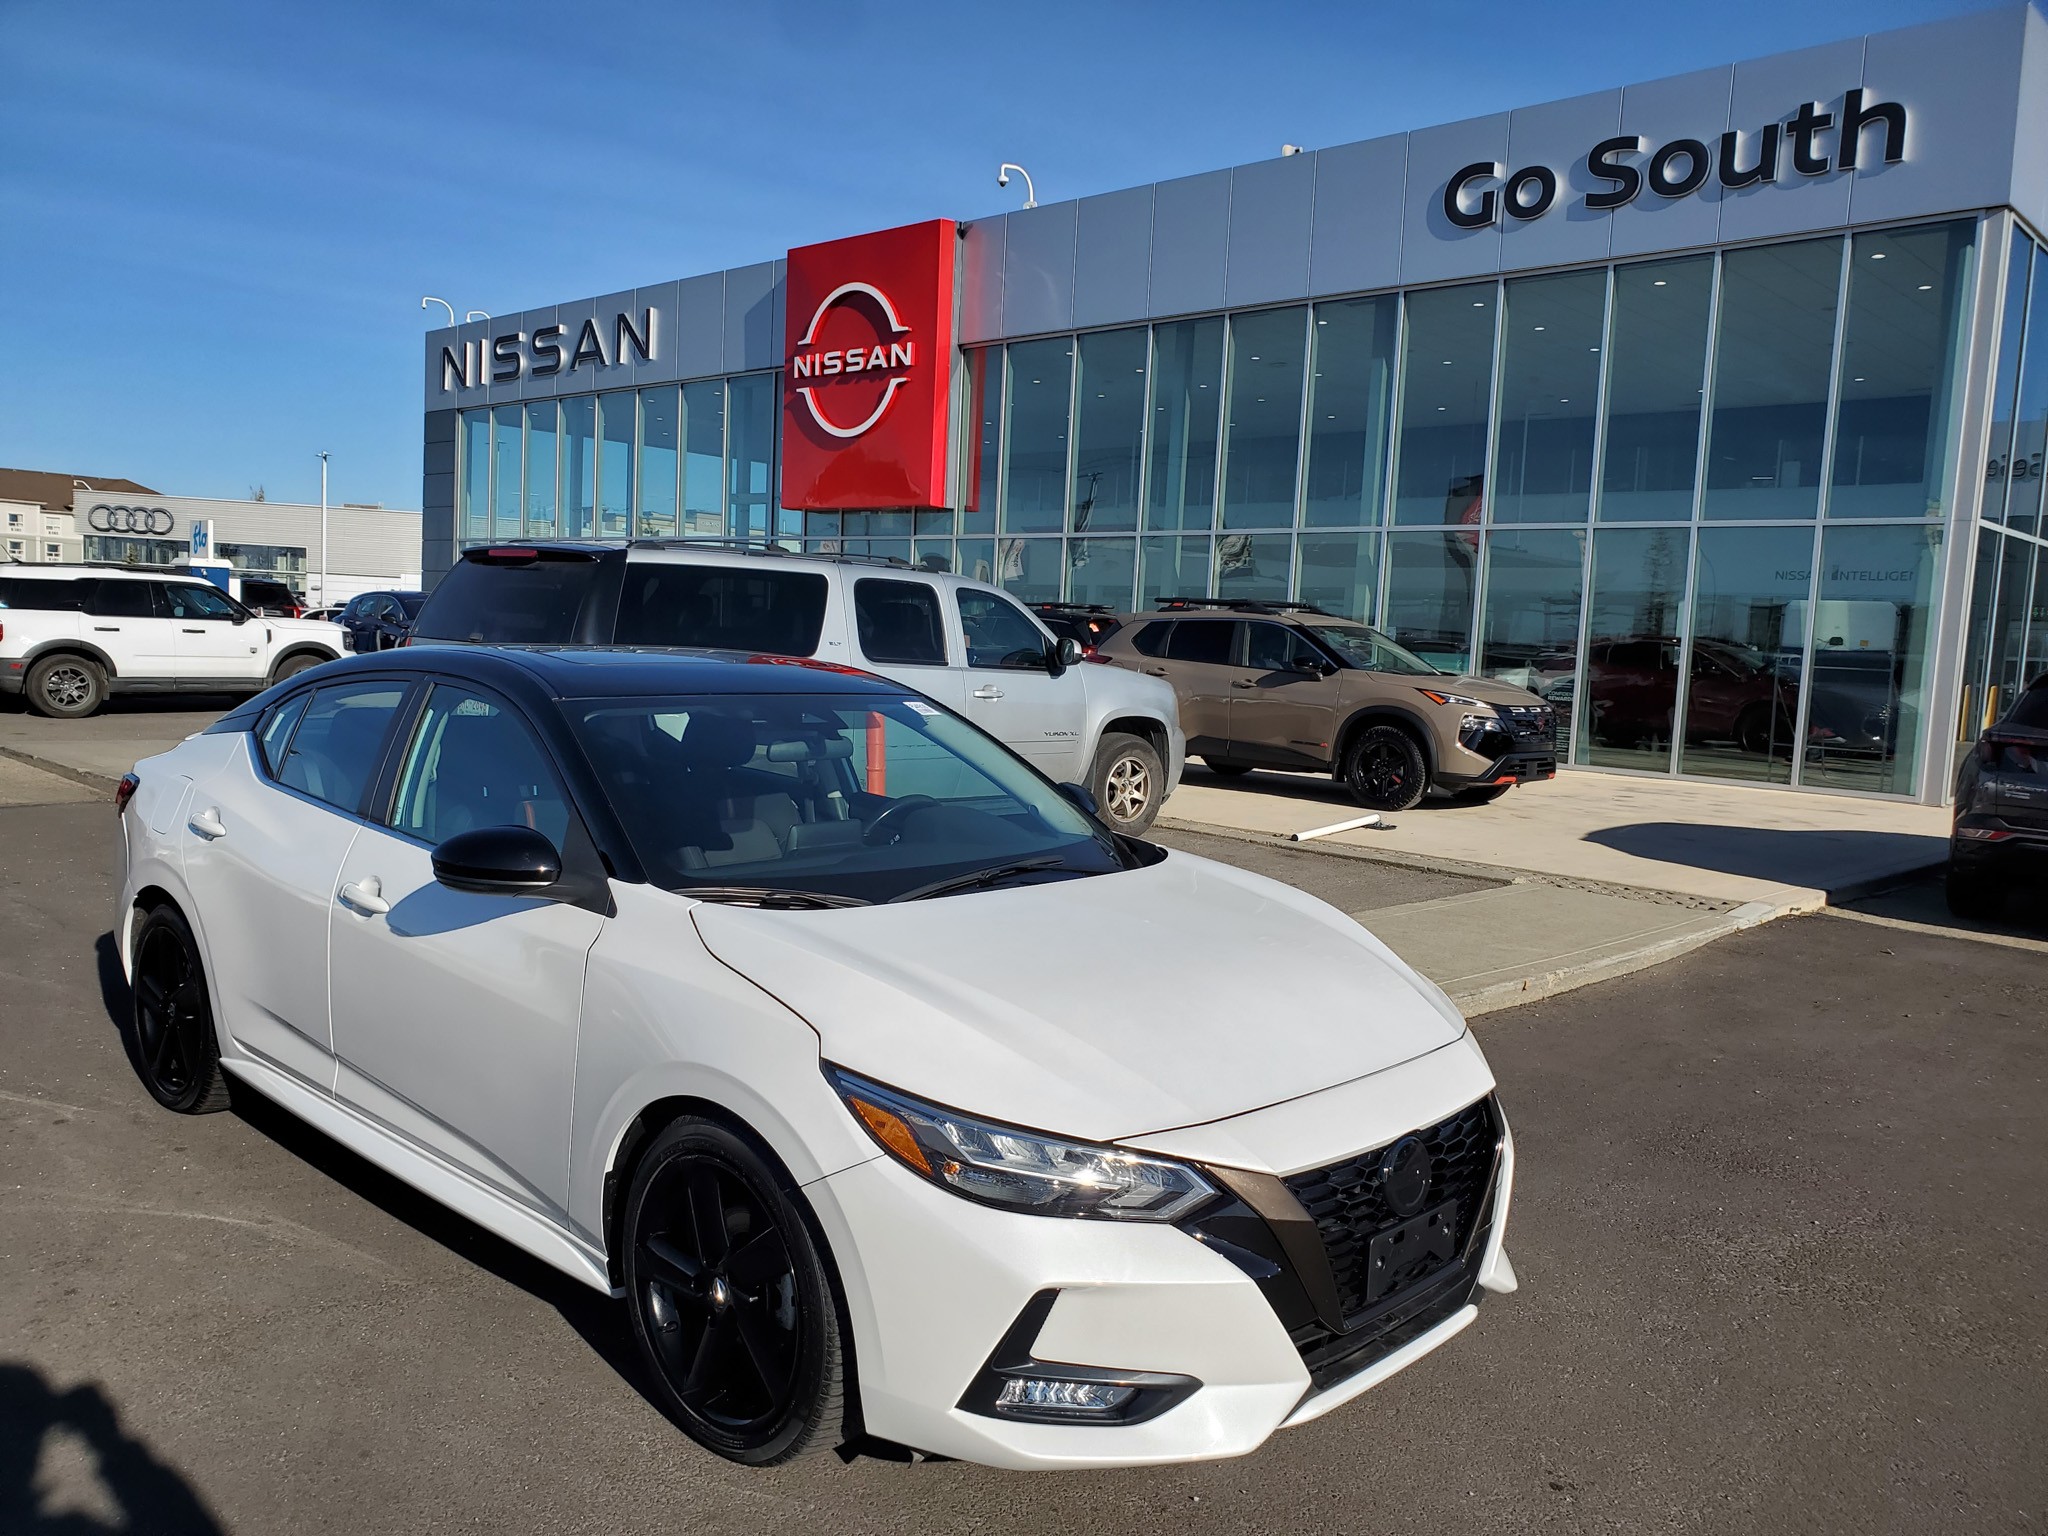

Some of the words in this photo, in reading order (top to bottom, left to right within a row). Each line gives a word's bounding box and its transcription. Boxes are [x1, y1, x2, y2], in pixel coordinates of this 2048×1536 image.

[1443, 161, 1557, 229] Go
[1585, 88, 1906, 209] South
[442, 307, 655, 391] NISSAN
[793, 342, 914, 379] NISSAN
[193, 520, 208, 554] flo
[1775, 570, 1825, 581] NISSA
